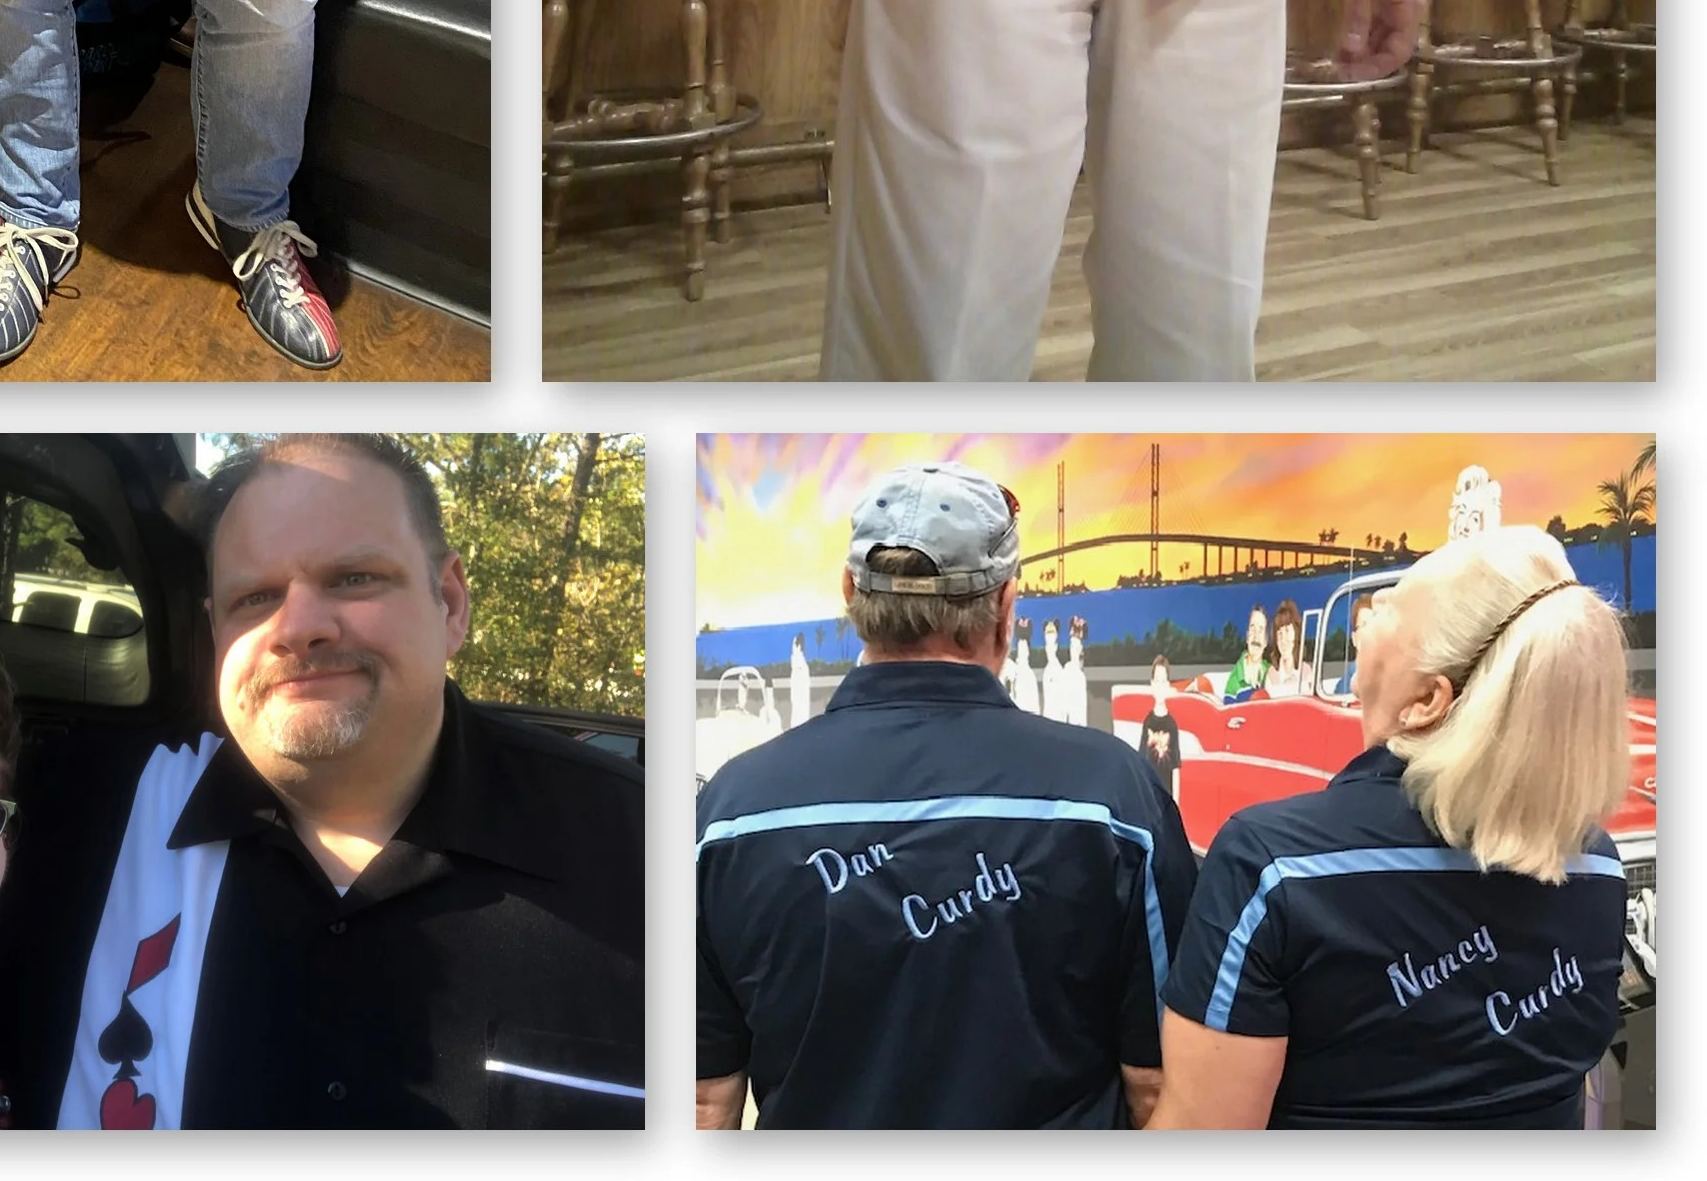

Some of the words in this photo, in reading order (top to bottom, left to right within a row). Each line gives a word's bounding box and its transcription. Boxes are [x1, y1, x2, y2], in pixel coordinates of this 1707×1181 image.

[805, 843, 894, 894] Dan
[902, 852, 1022, 939] Curdy
[1387, 925, 1499, 1007] Nancy
[1486, 947, 1584, 1036] Curdy
